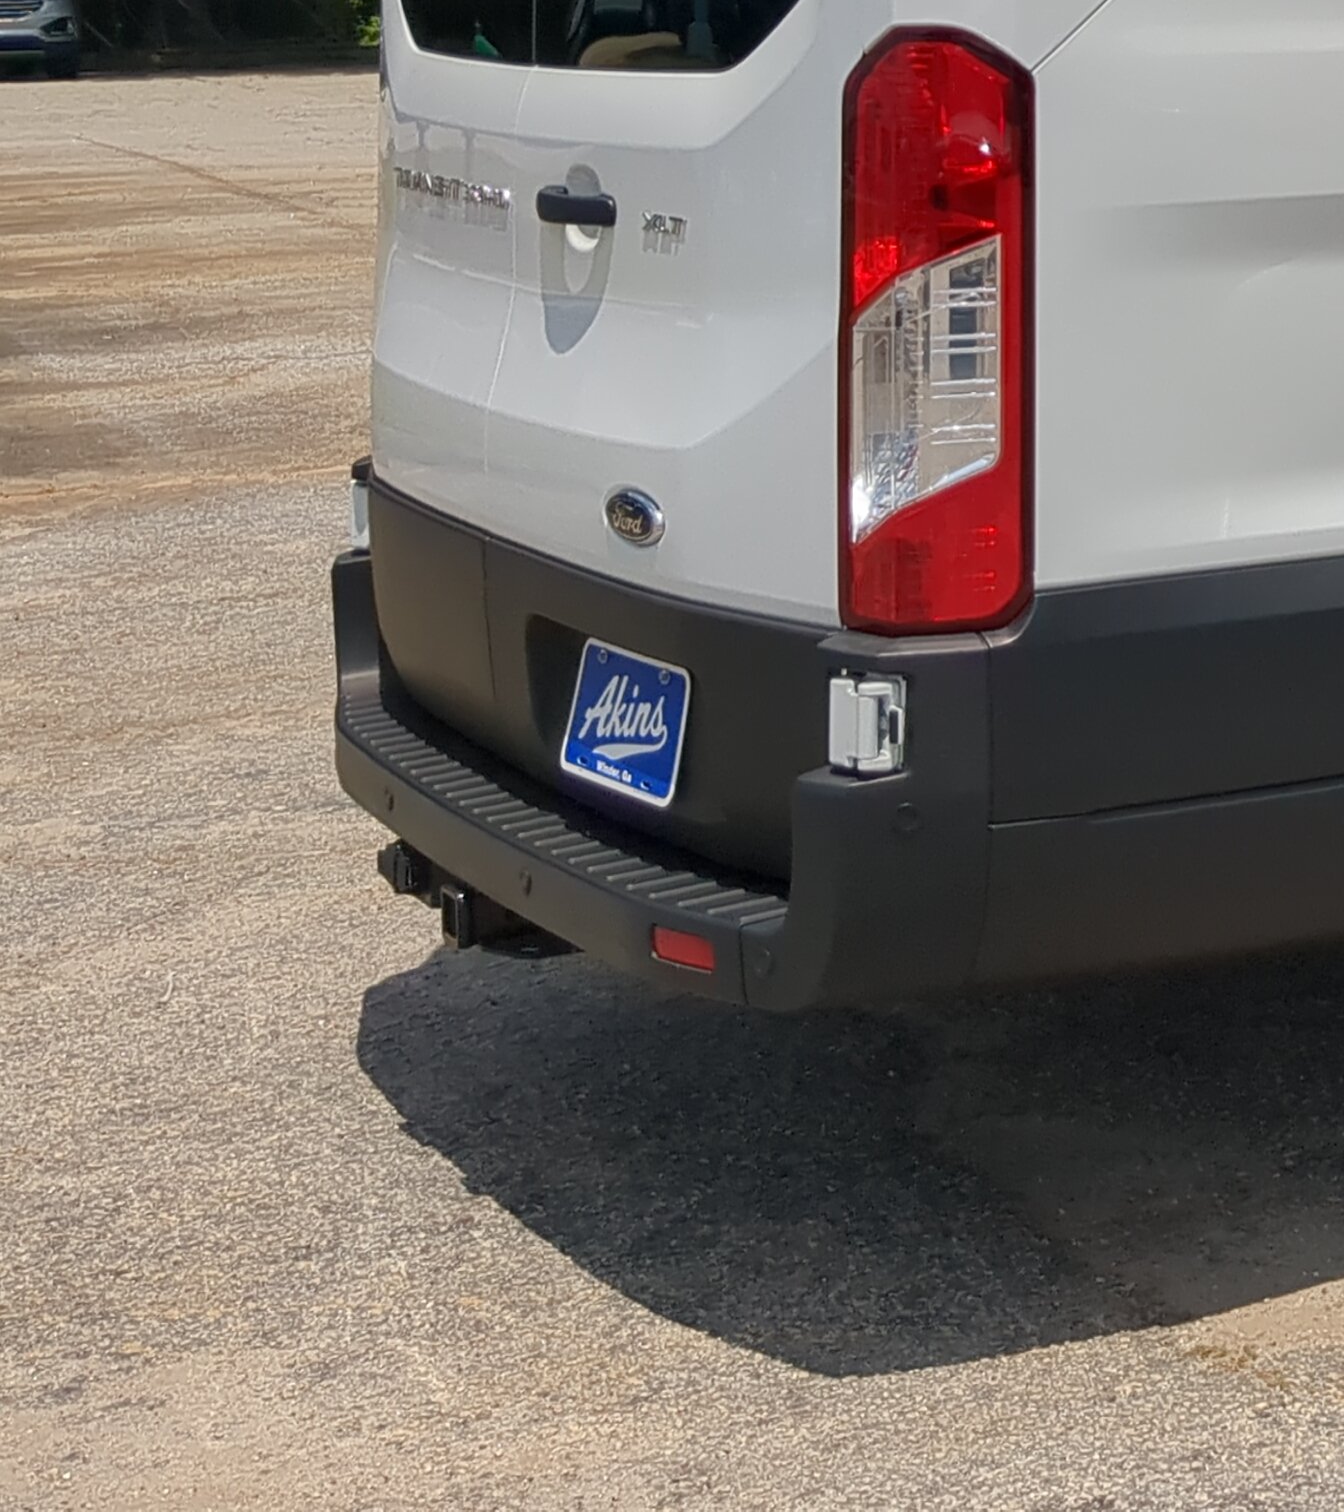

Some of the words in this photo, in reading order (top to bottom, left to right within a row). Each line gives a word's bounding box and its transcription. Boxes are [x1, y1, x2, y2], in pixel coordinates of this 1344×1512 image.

[642, 211, 686, 236] XLT
[612, 501, 644, 534] Ford
[577, 674, 668, 740] Akins
